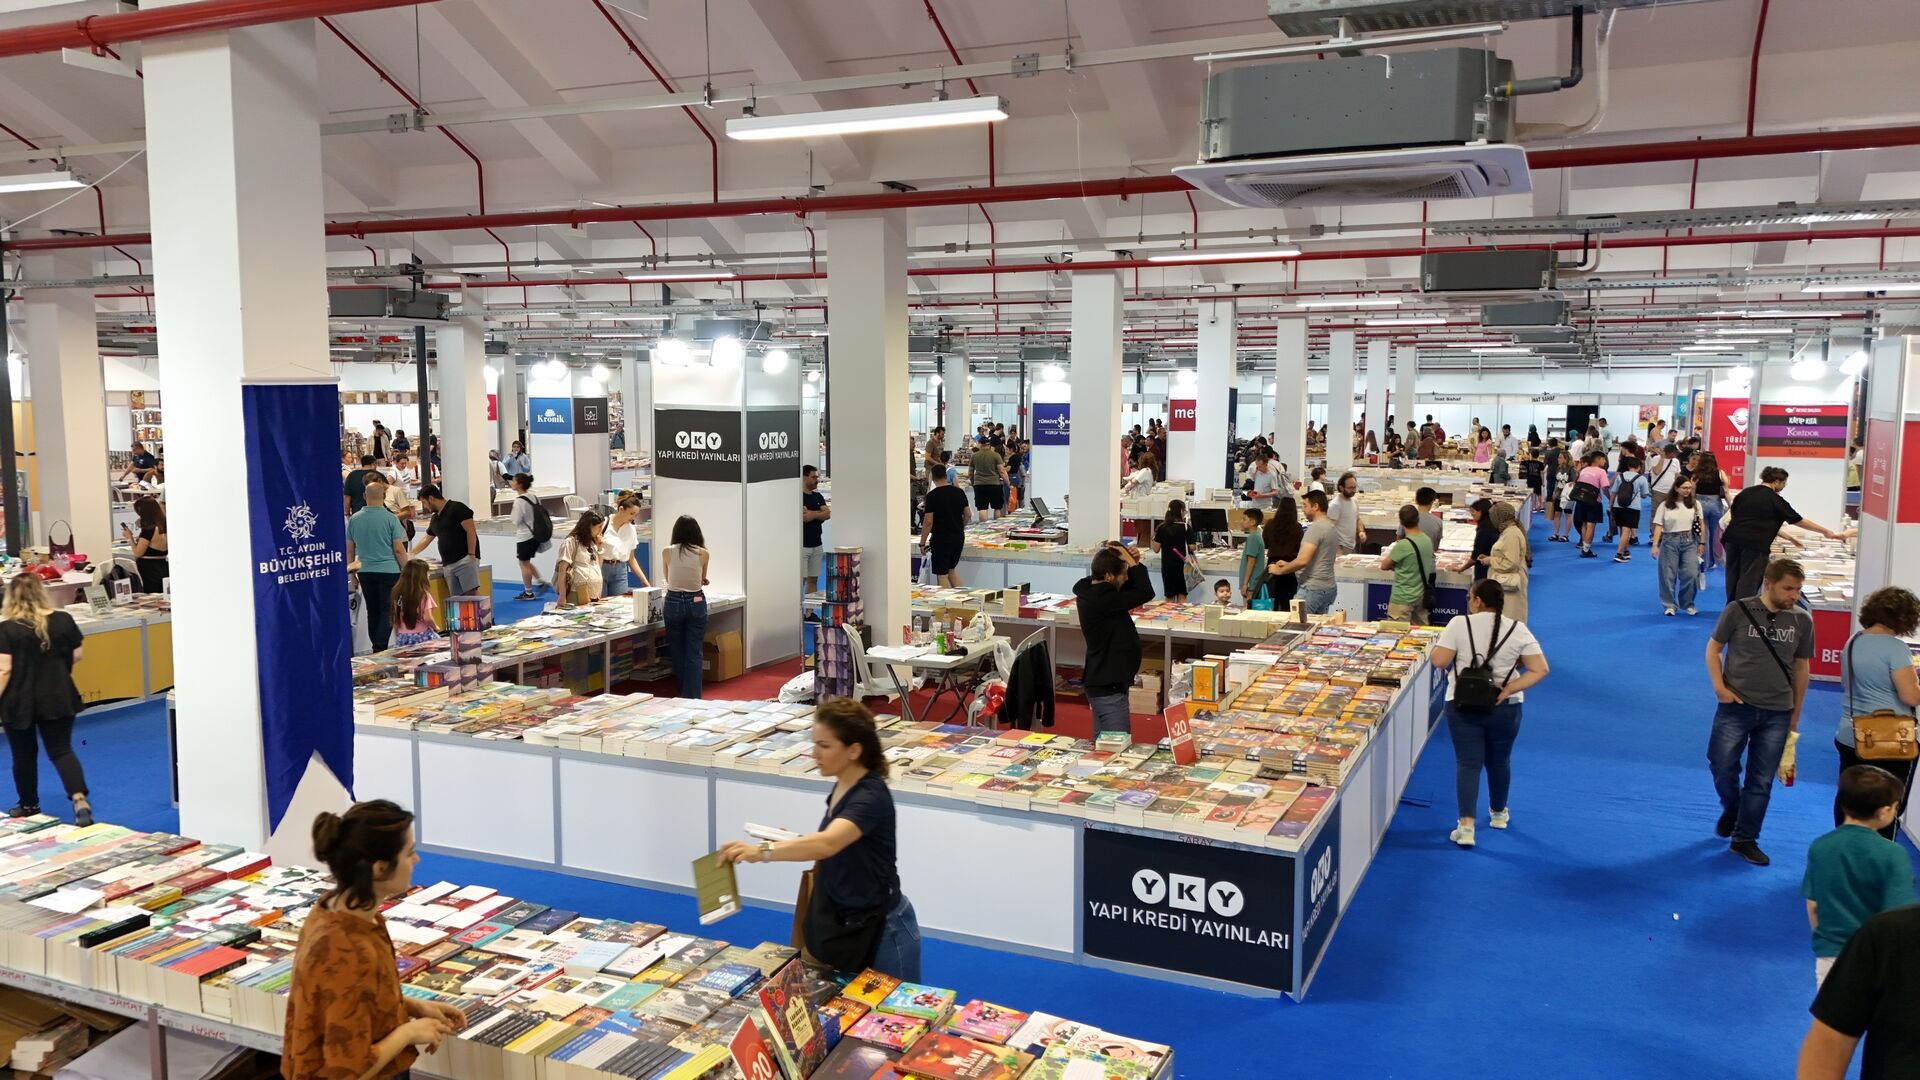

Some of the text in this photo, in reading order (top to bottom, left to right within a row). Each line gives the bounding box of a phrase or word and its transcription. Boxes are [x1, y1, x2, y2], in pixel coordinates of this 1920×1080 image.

[537, 414, 565, 423] Kronik
[657, 450, 741, 463] YAPI KREDİ YAYINLARI
[747, 449, 799, 462] YAPI KREDİ YAYINLARI
[280, 542, 325, 556] T.C. AYDIN
[260, 550, 342, 574] BÜYÜKŞEHİR
[277, 566, 330, 585] BELEDİYESİ
[1135, 873, 1240, 912] YKY
[1089, 900, 1290, 950] YAPI KREDİ YAYINLARI
